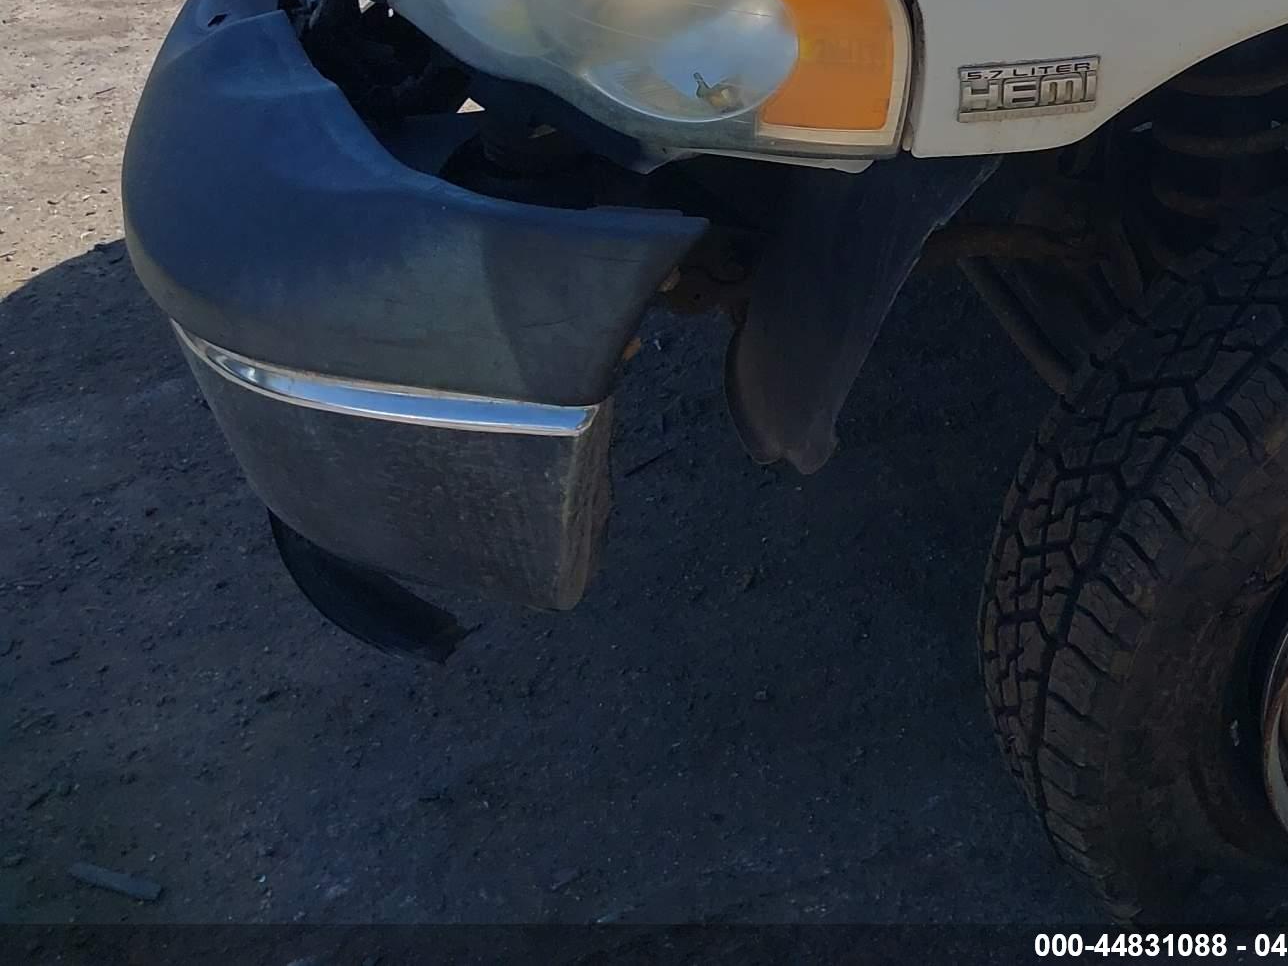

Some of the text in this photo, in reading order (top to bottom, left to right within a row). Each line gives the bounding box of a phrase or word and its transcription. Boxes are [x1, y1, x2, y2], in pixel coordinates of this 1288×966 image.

[967, 62, 1091, 80] 5.7 LITER
[960, 70, 1098, 113] HEMI
